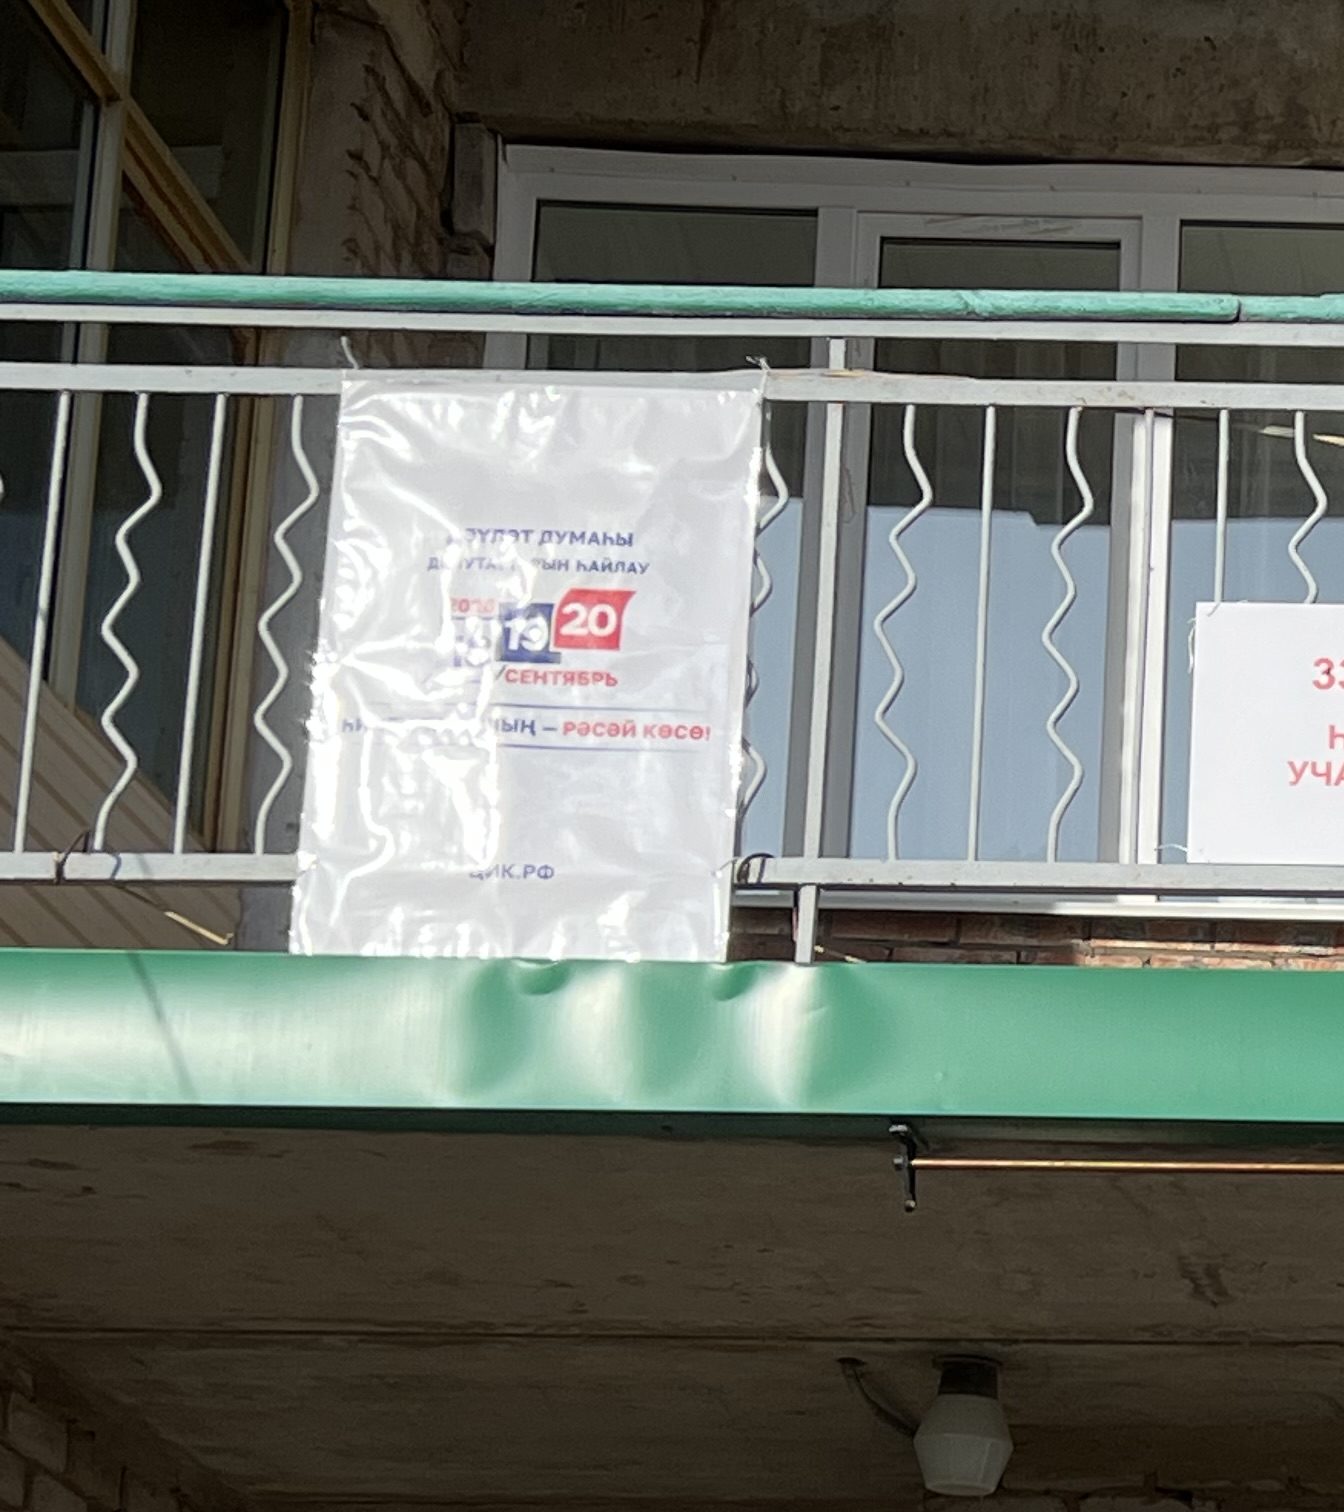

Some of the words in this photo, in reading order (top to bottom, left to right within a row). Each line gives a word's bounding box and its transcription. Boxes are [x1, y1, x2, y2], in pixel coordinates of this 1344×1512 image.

[447, 528, 534, 546] ӘҮЛӘТ
[538, 529, 634, 547] ДУМАҺЫ
[576, 557, 650, 575] ҺАЙЛАУ
[559, 602, 618, 637] 20
[505, 668, 618, 687] СЕНТЯБРЬ
